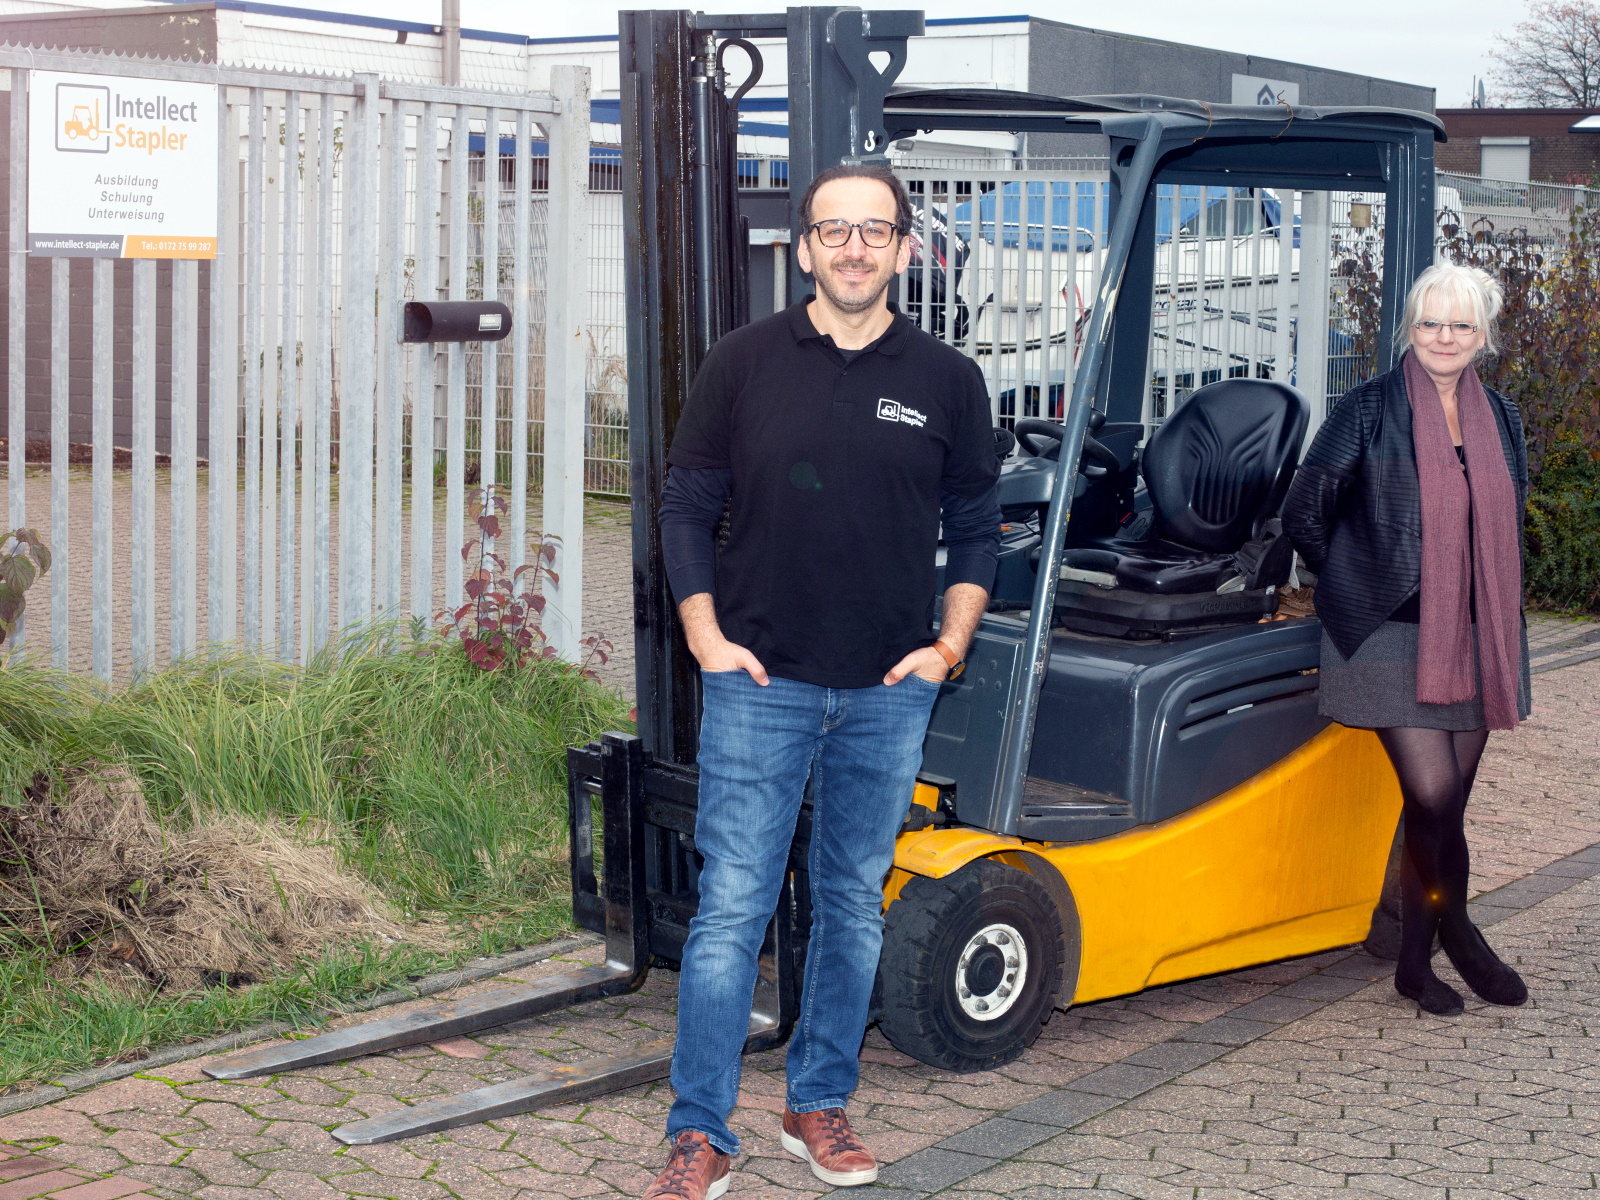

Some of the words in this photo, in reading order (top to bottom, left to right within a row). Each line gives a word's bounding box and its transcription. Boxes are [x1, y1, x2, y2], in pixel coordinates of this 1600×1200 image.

[115, 93, 198, 123] Intellect
[115, 123, 188, 156] Stapler
[94, 173, 159, 189] Ausbildung
[100, 190, 153, 206] Schulung
[88, 207, 165, 223] Unterweisung
[35, 239, 120, 251] www.intellect-stapler.de
[141, 241, 157, 250] Tel.:
[158, 241, 177, 250] 0172
[178, 242, 187, 251] 75
[188, 242, 197, 251] 99
[198, 242, 212, 251] 287
[900, 413, 924, 428] Stapler
[901, 405, 927, 423] Intellect
